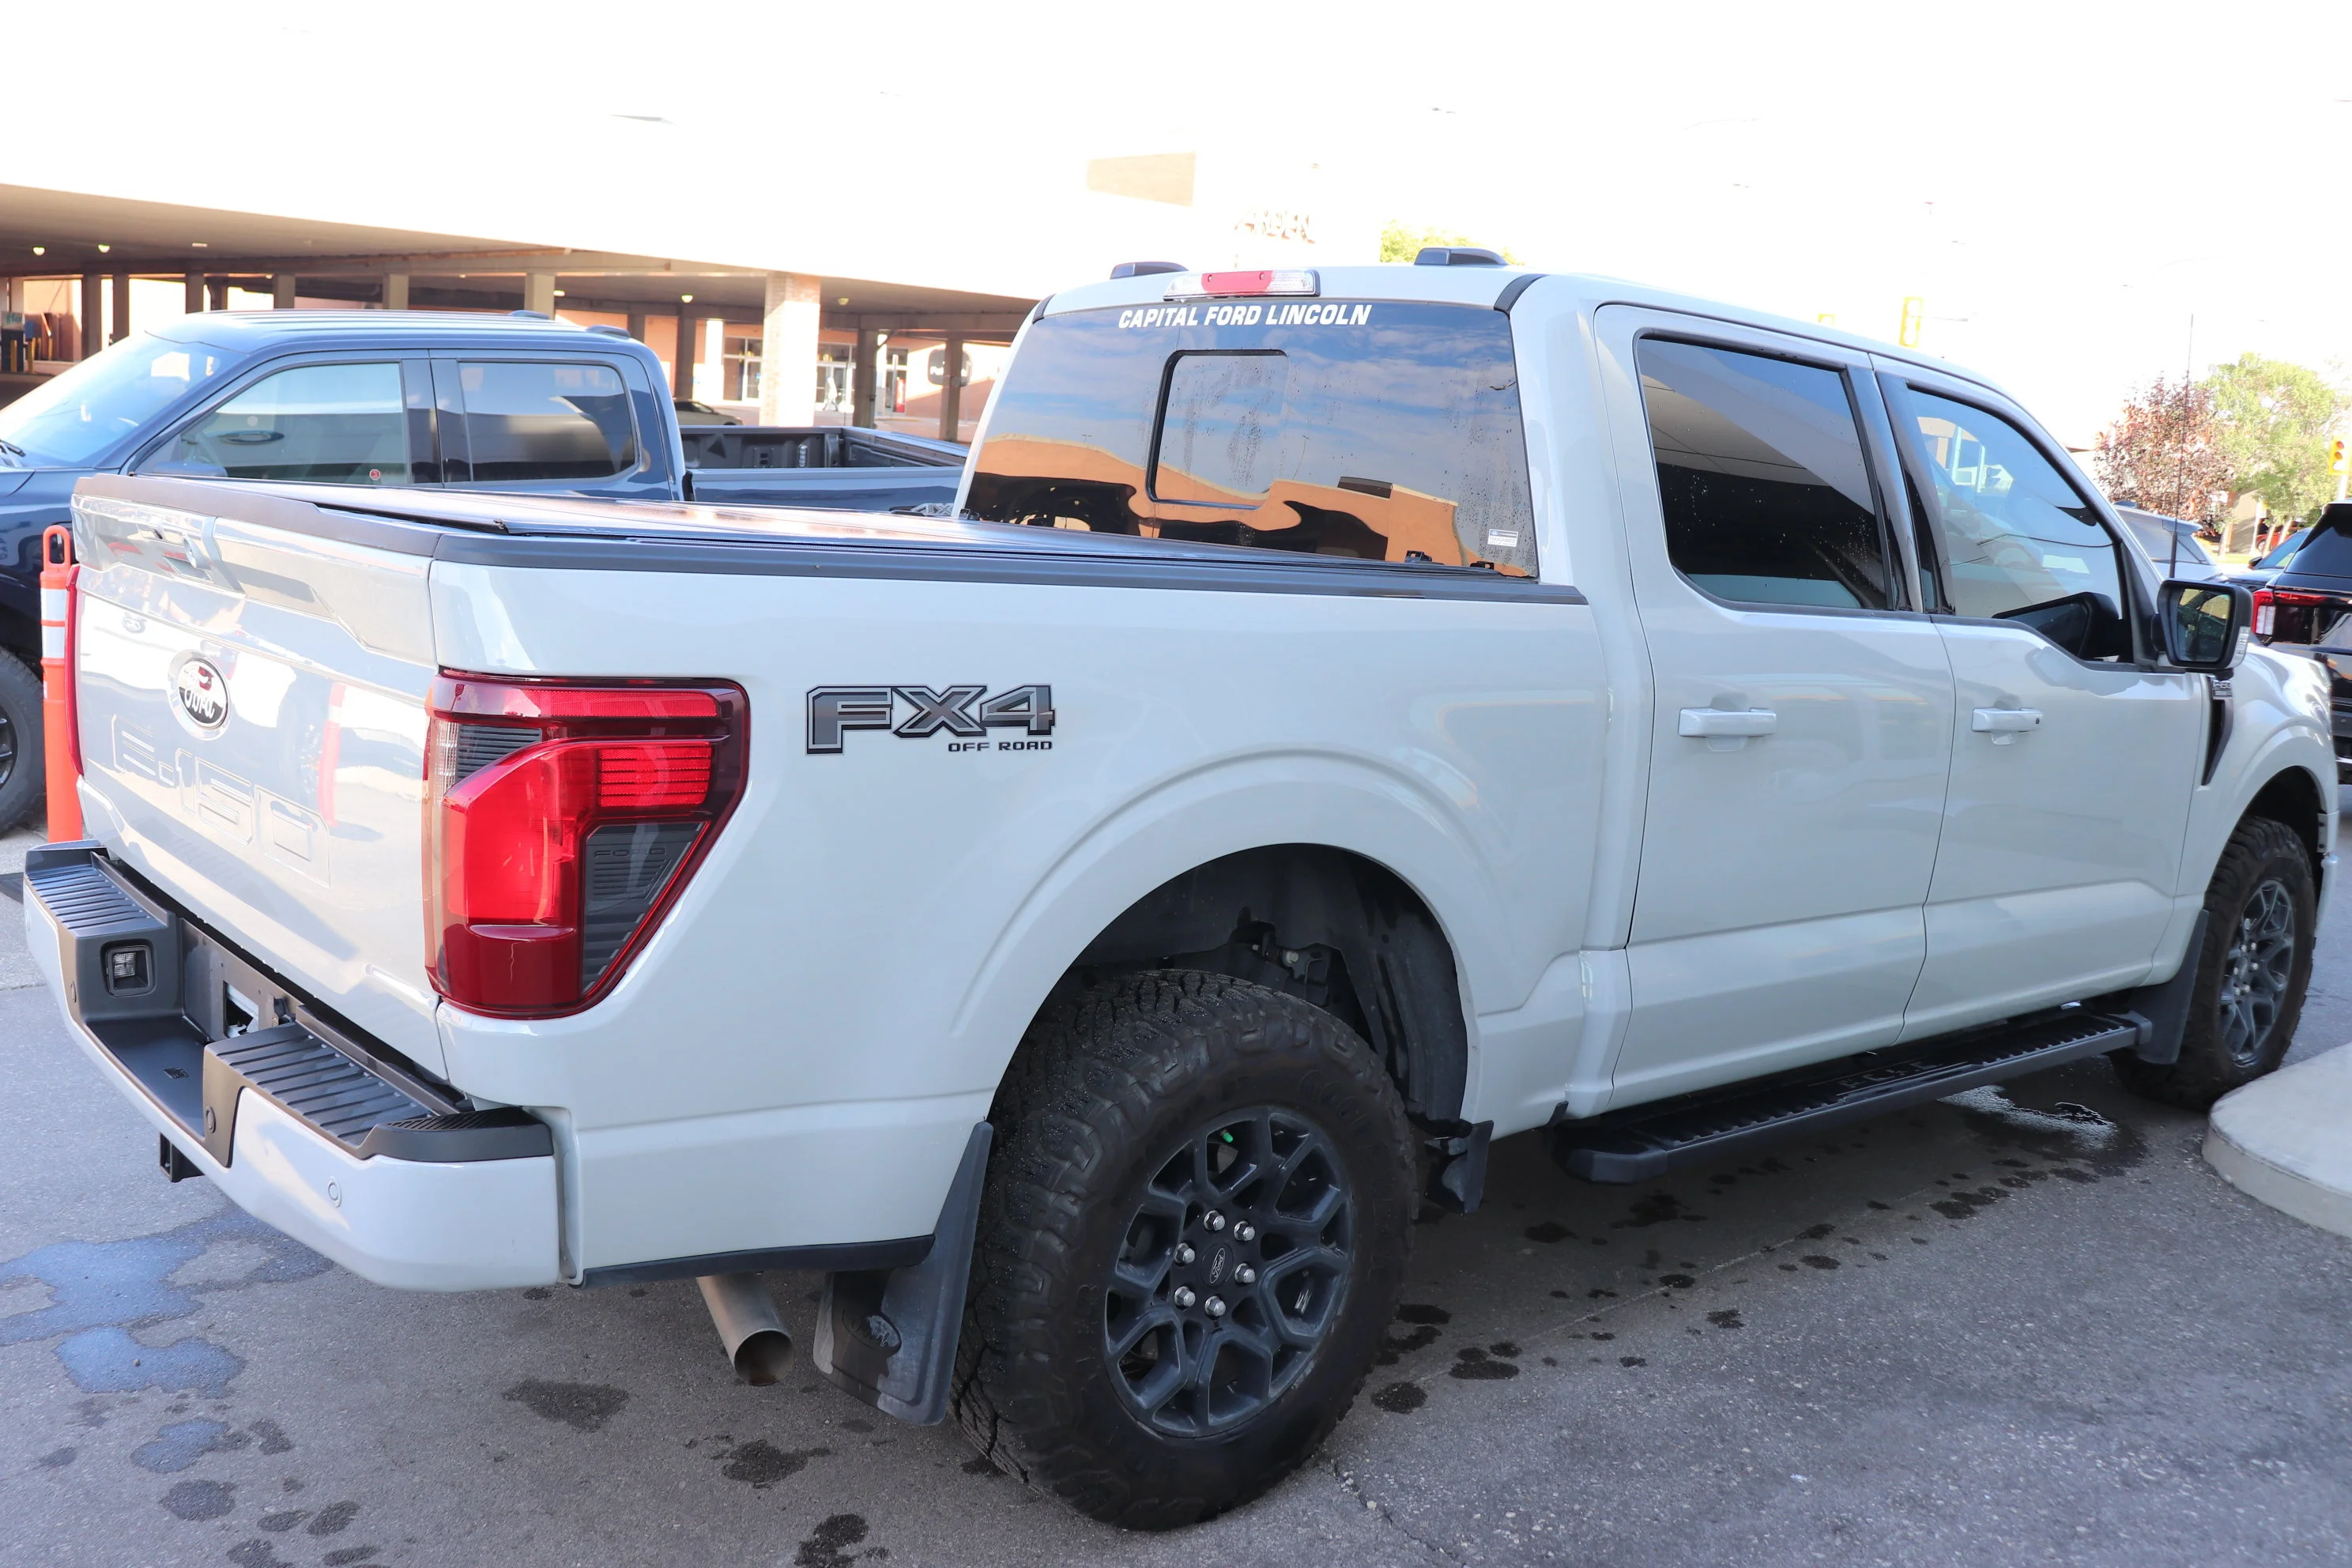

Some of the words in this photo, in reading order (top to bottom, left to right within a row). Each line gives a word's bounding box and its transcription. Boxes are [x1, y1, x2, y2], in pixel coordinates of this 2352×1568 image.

[1118, 307, 1199, 329] CAPITAL
[1204, 305, 1262, 326] FORD
[1265, 304, 1372, 326] LINCOLN
[805, 684, 1055, 754] FX4
[948, 742, 990, 752] OFF
[998, 741, 1053, 752] ROAD
[594, 847, 665, 858] FOD
